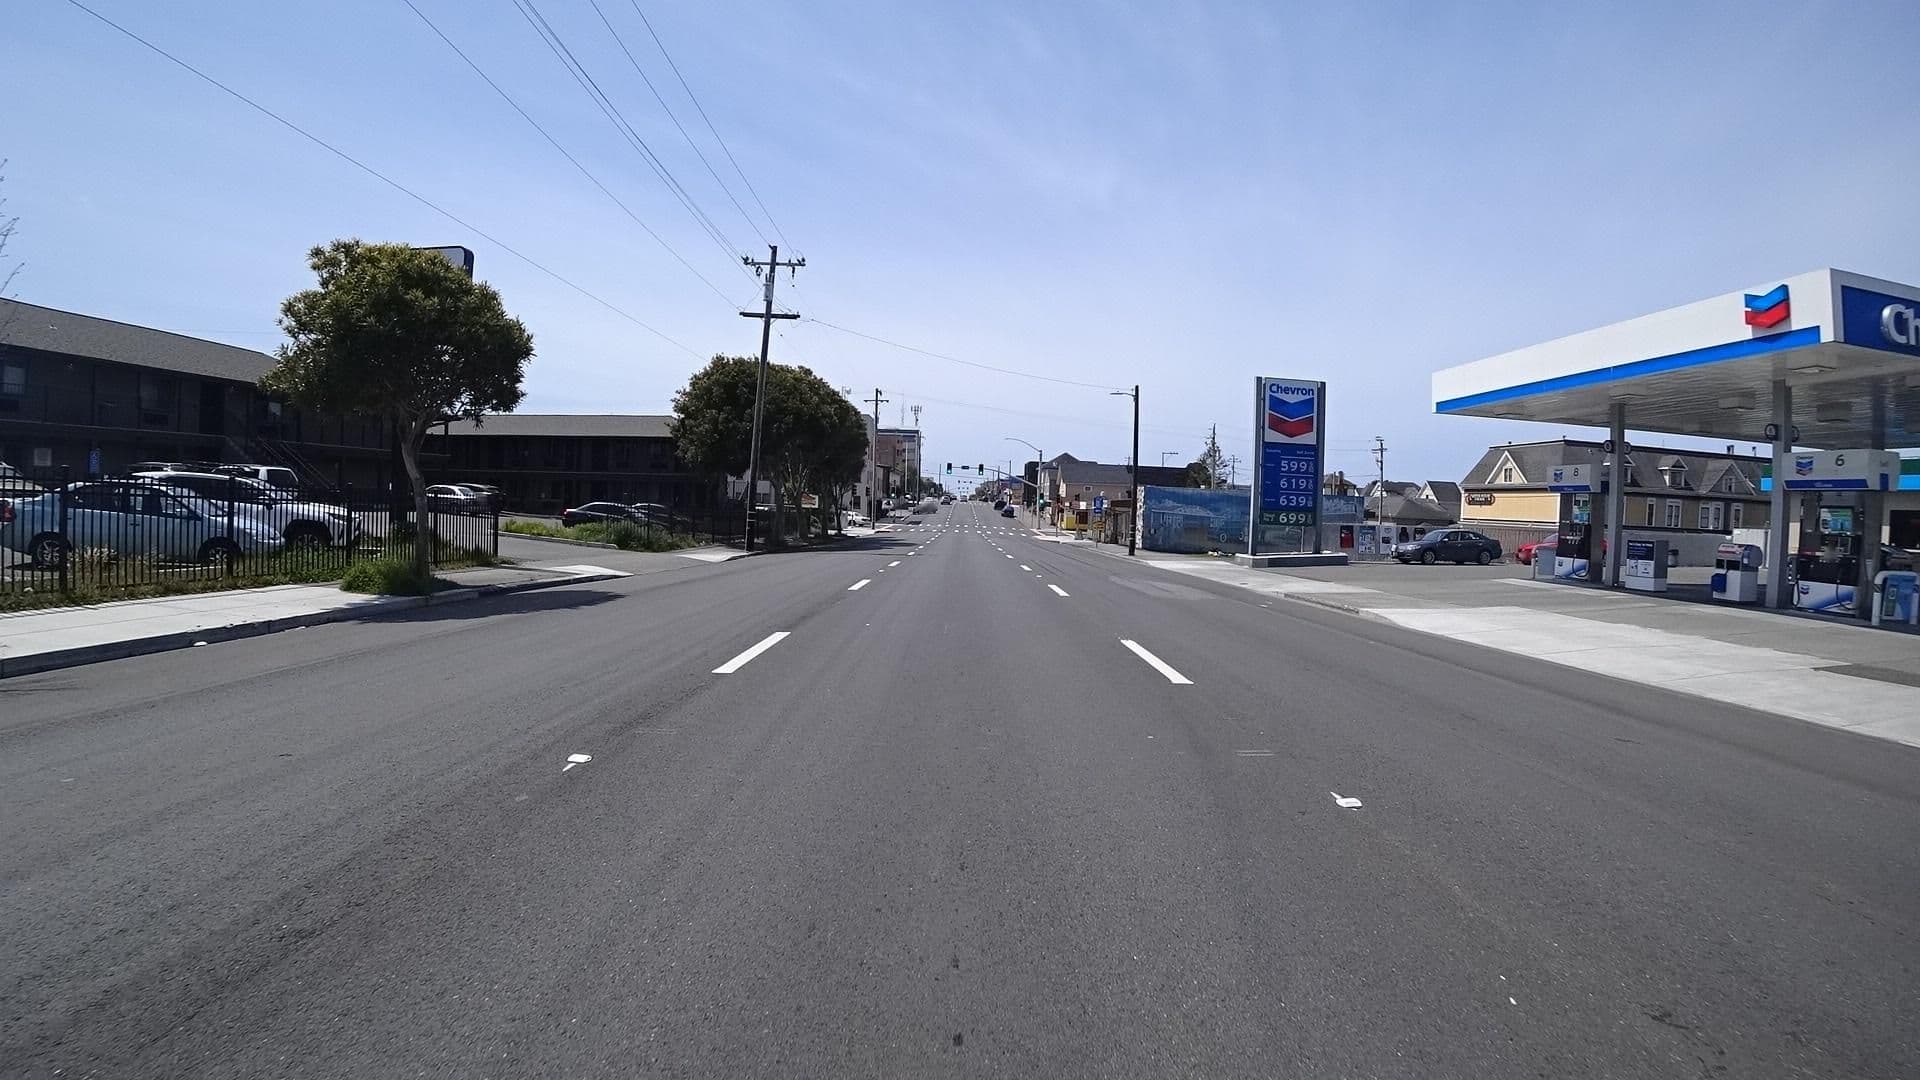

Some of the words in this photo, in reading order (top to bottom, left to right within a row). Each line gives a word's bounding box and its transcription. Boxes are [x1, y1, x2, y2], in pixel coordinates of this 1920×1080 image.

[1269, 384, 1314, 396] Chevron
[1281, 460, 1307, 472] 599
[1835, 453, 1845, 467] 6
[1280, 478, 1307, 489] 619
[1279, 495, 1306, 506] 639
[1279, 512, 1306, 524] 699
